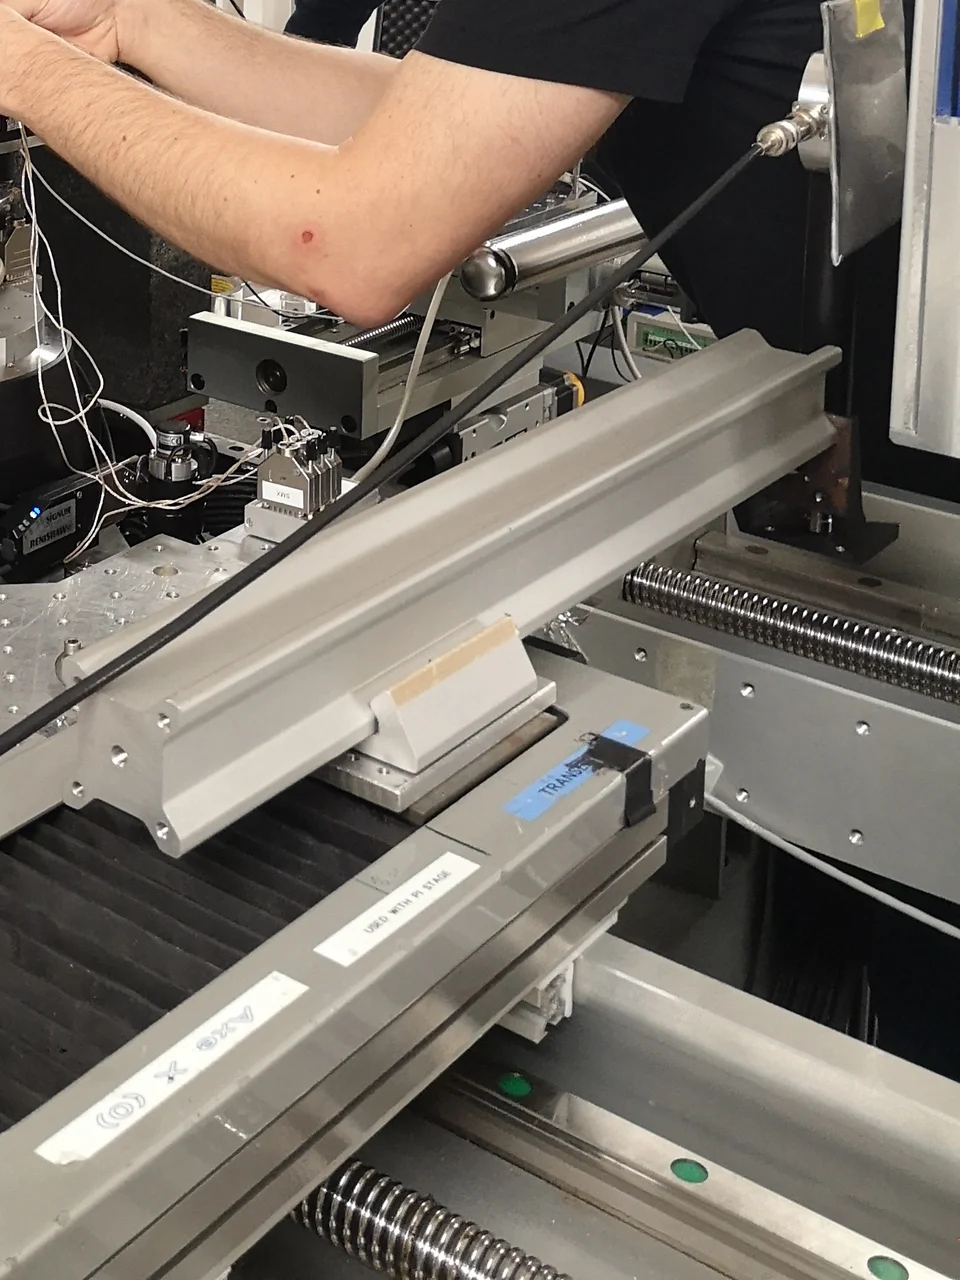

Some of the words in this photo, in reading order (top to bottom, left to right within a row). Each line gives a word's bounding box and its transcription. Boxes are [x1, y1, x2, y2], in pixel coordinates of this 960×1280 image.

[363, 915, 388, 934] USED
[389, 898, 413, 915] WITH
[412, 889, 424, 899] PI
[422, 869, 452, 891] STAGE
[196, 1005, 255, 1052] Axe
[153, 1060, 189, 1084] X
